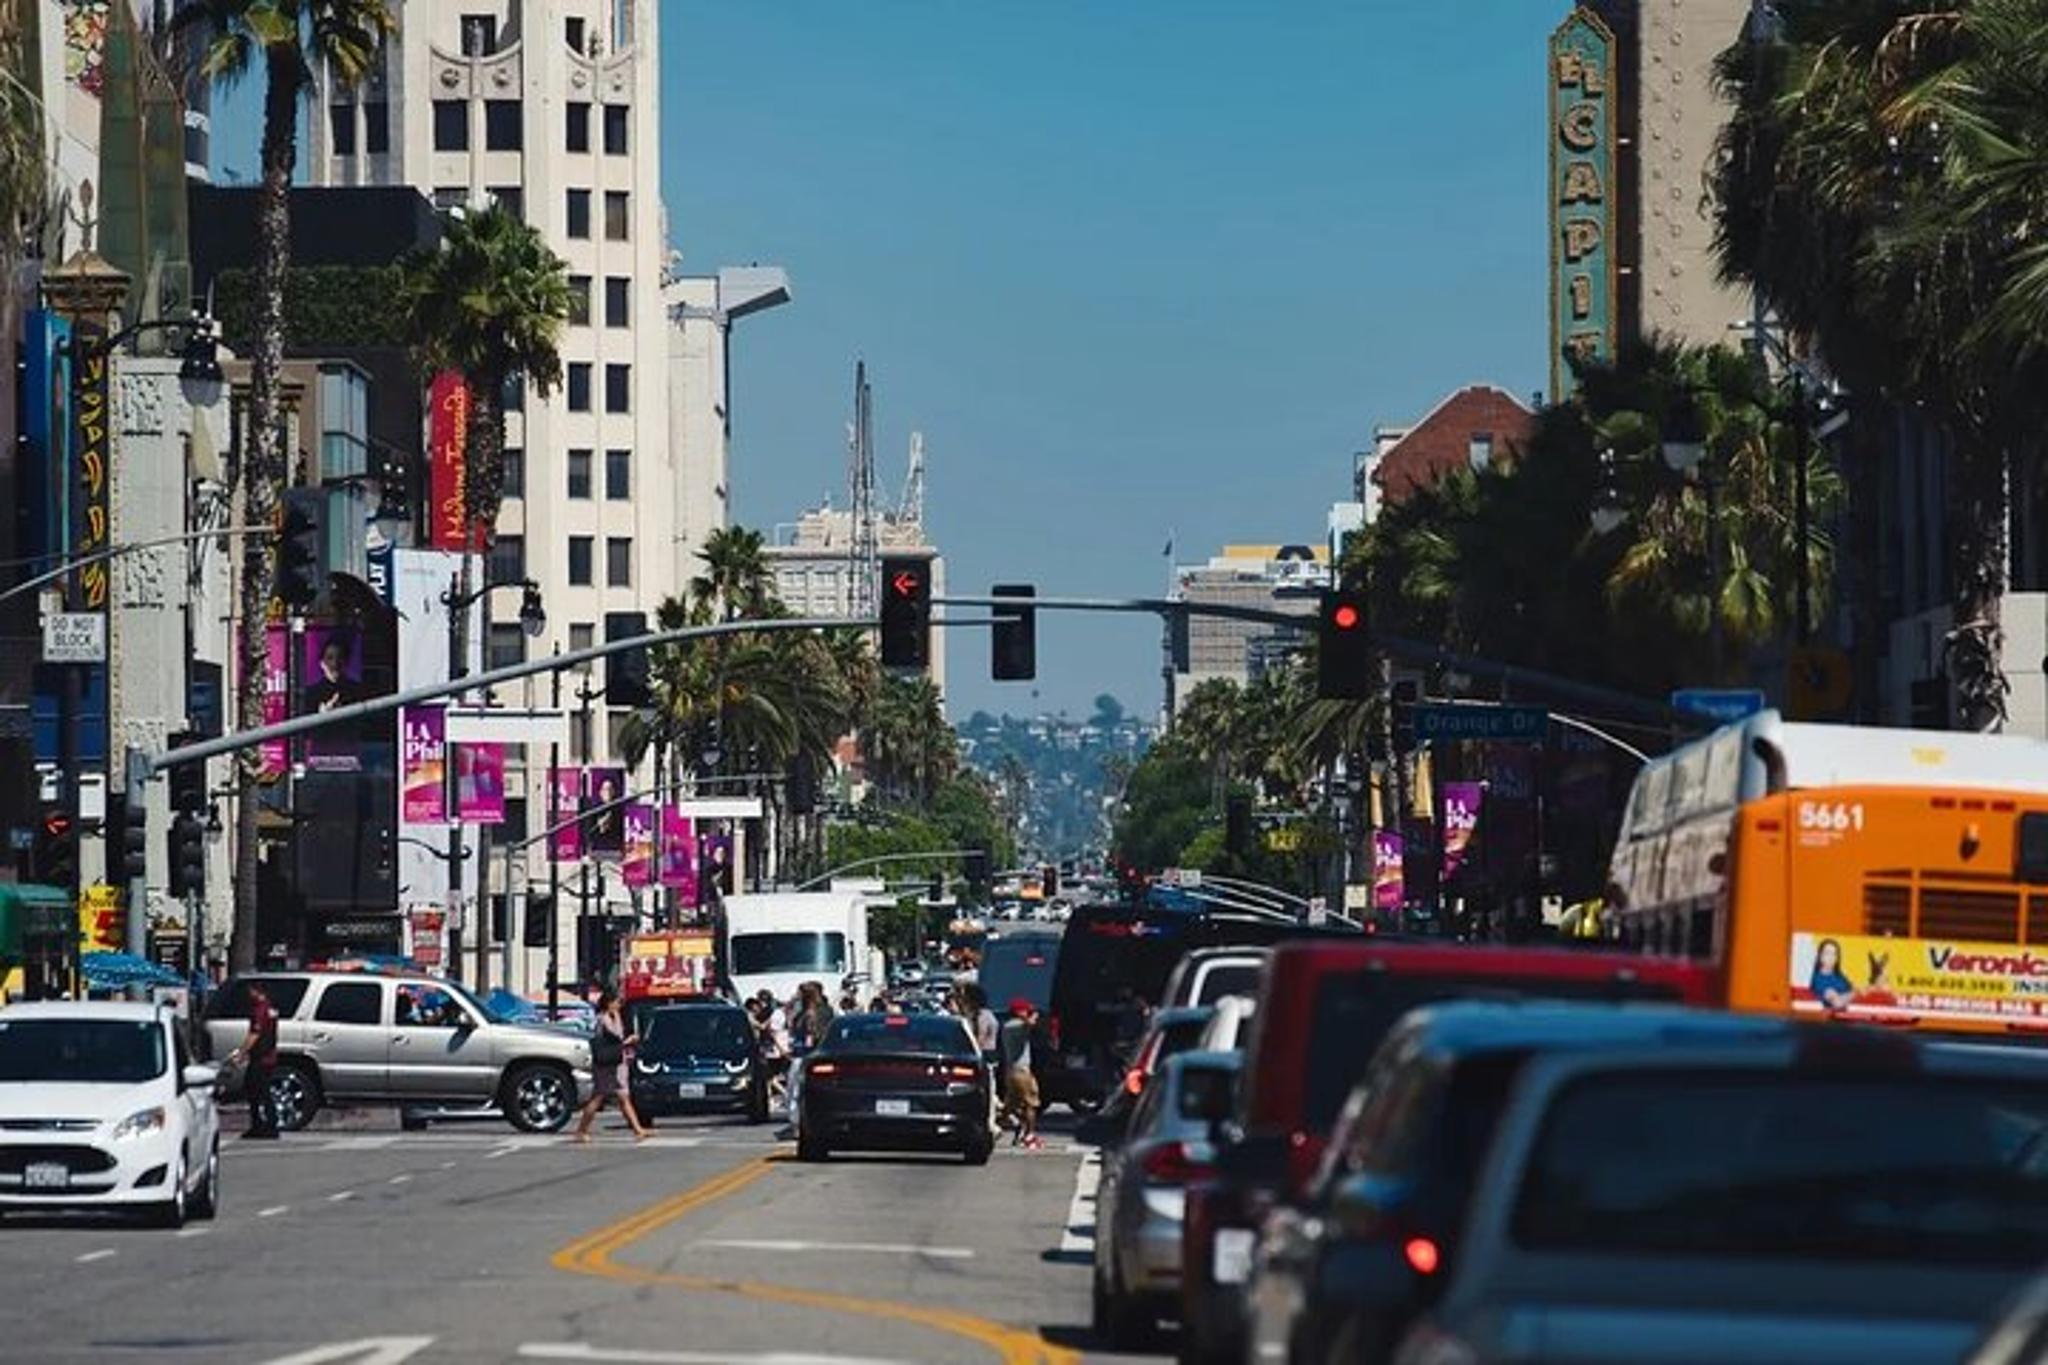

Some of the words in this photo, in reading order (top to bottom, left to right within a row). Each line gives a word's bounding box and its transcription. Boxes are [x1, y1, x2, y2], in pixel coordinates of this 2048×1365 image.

[1557, 52, 1605, 97] EL
[51, 617, 69, 631] DO
[73, 617, 95, 631] NOT
[54, 633, 91, 646] BLOCK
[406, 721, 431, 740] LA
[1424, 711, 1503, 731] Orange
[1512, 711, 1536, 730] Dr
[406, 740, 444, 761] Phil
[1445, 798, 1467, 813] LA
[1799, 801, 1864, 831] 5661
